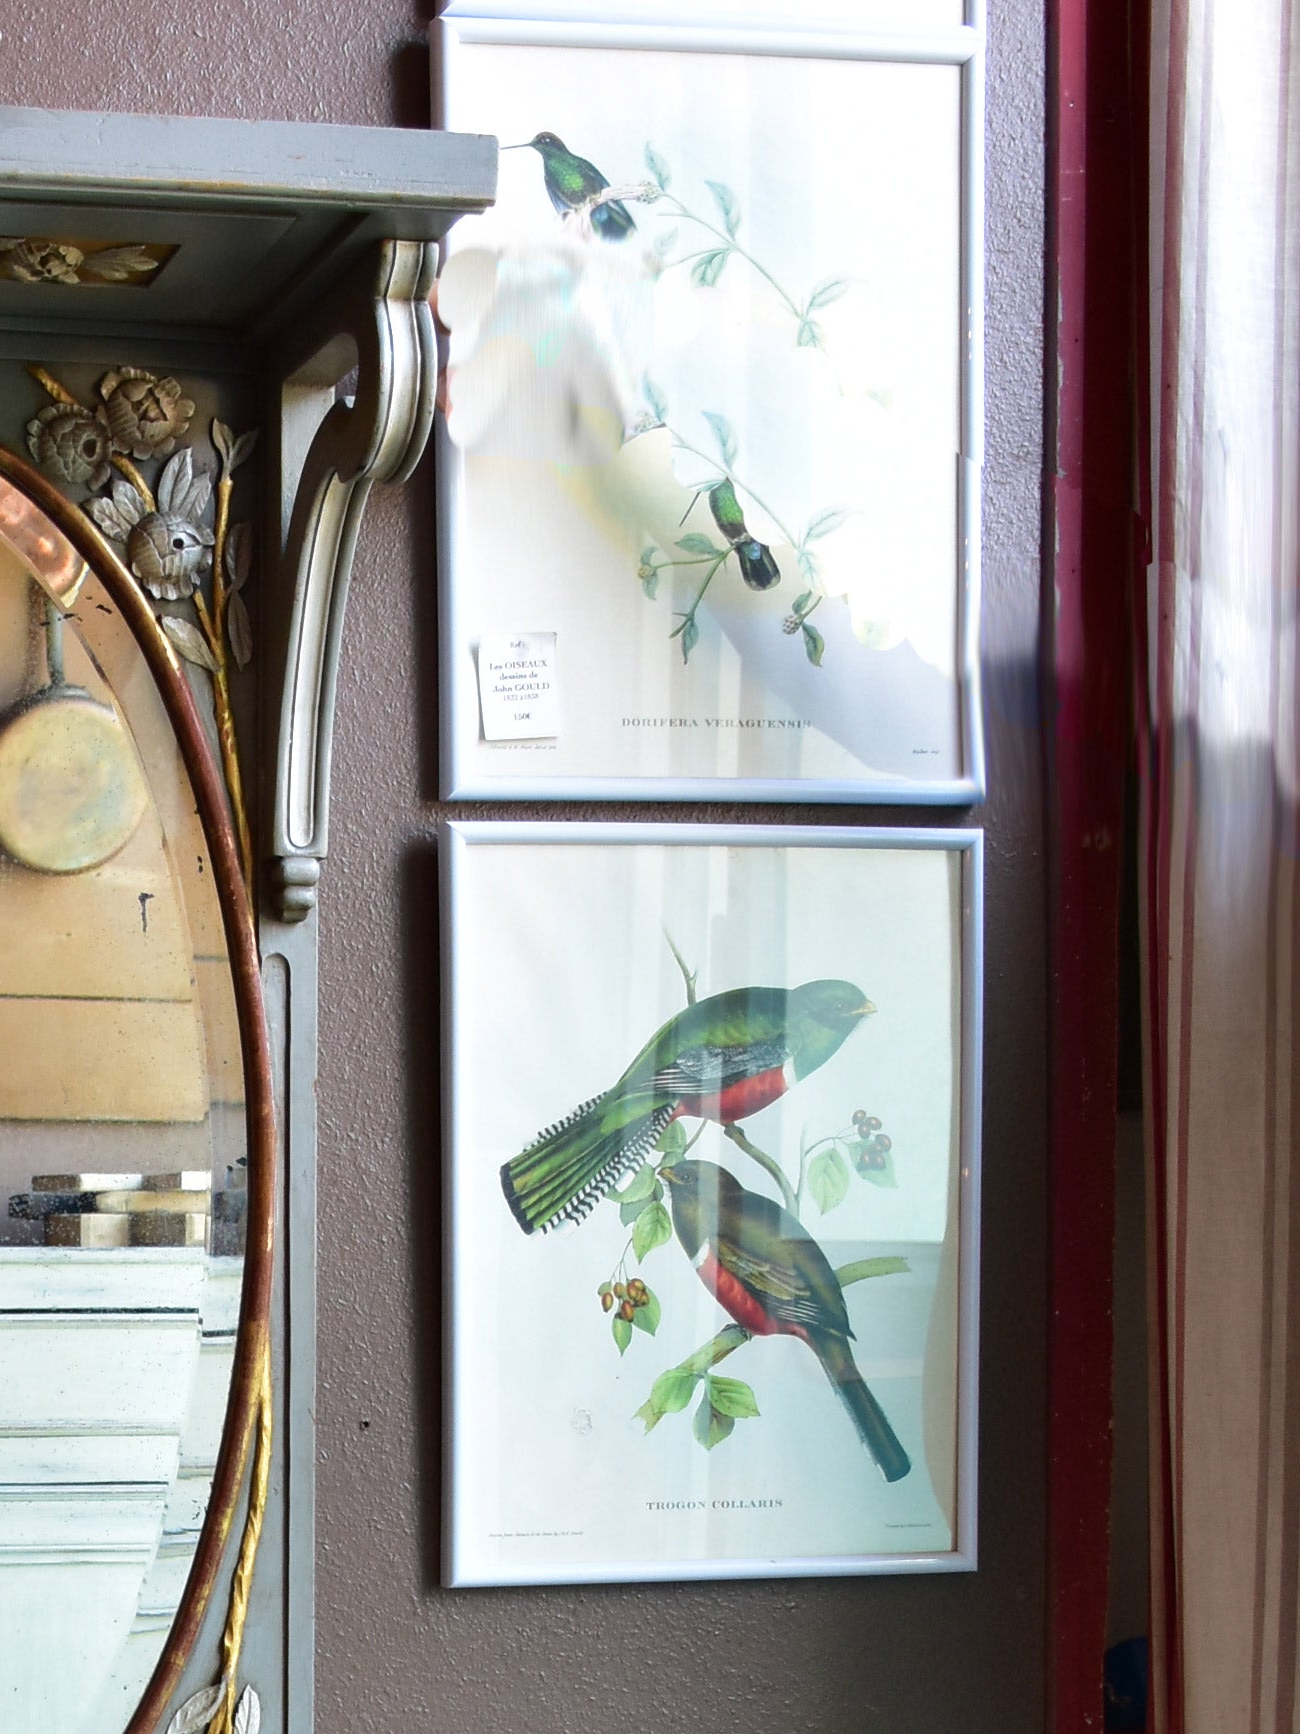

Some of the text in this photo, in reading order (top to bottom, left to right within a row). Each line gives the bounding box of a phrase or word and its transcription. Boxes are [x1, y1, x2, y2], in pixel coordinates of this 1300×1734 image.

[505, 660, 547, 669] OISEAUX
[500, 672, 527, 680] dessins
[493, 682, 549, 693] John GOULD
[622, 718, 811, 728] DORIFERA VERAGUENSIS
[646, 1499, 782, 1510] TROGON COLLARIS
